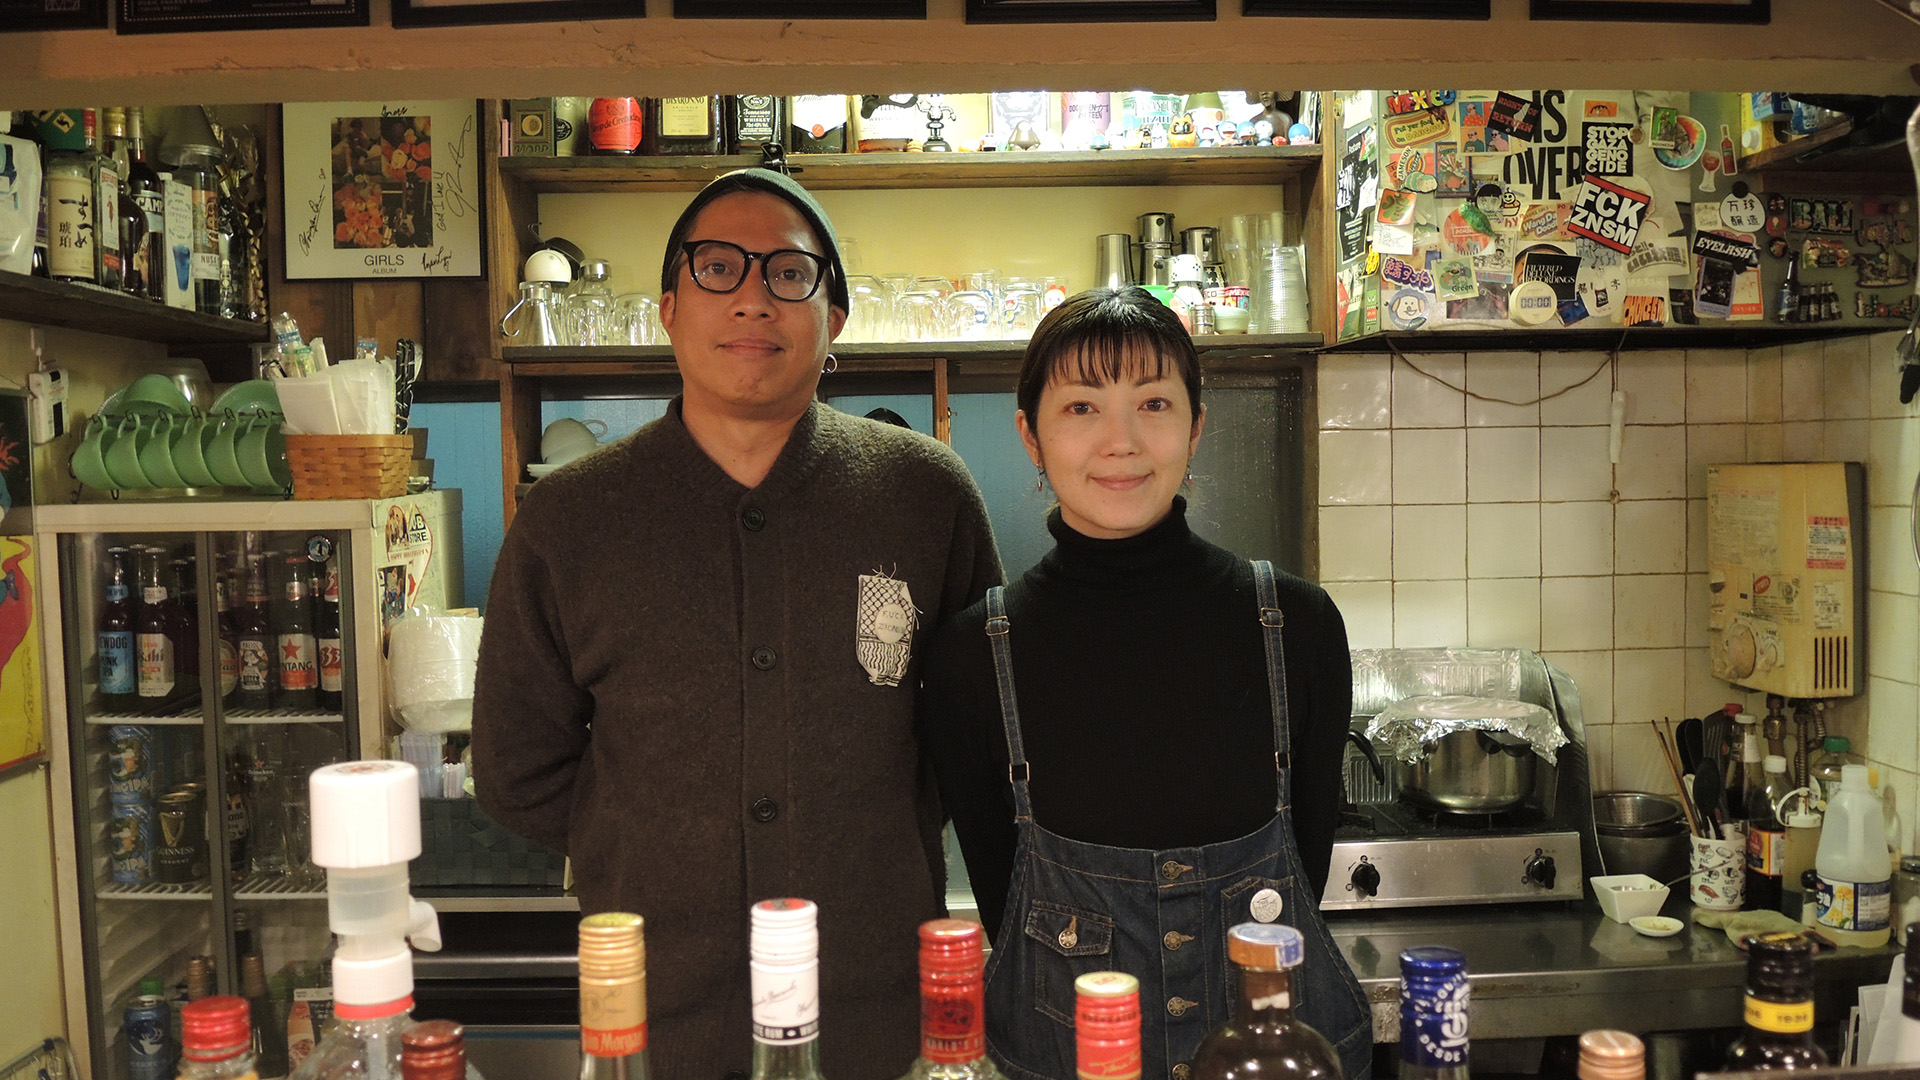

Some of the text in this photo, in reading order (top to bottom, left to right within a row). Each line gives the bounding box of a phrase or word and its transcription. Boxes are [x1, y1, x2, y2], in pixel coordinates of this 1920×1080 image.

[1491, 111, 1533, 133] RETURN
[1587, 125, 1629, 139] STOP
[1587, 139, 1628, 150] GAZA
[1586, 149, 1629, 161] GENO
[1397, 147, 1412, 180] JAMESON
[1586, 160, 1627, 173] CIDE
[1503, 146, 1583, 200] OVER
[1576, 180, 1645, 229] FCK
[1536, 222, 1558, 235] Dood
[1570, 206, 1638, 247] ZNSM
[1697, 237, 1753, 259] EYELASH
[364, 254, 405, 266] GIRLS
[1451, 283, 1474, 293] Green
[409, 531, 428, 544] STORE
[1419, 1033, 1461, 1063] DESDE
